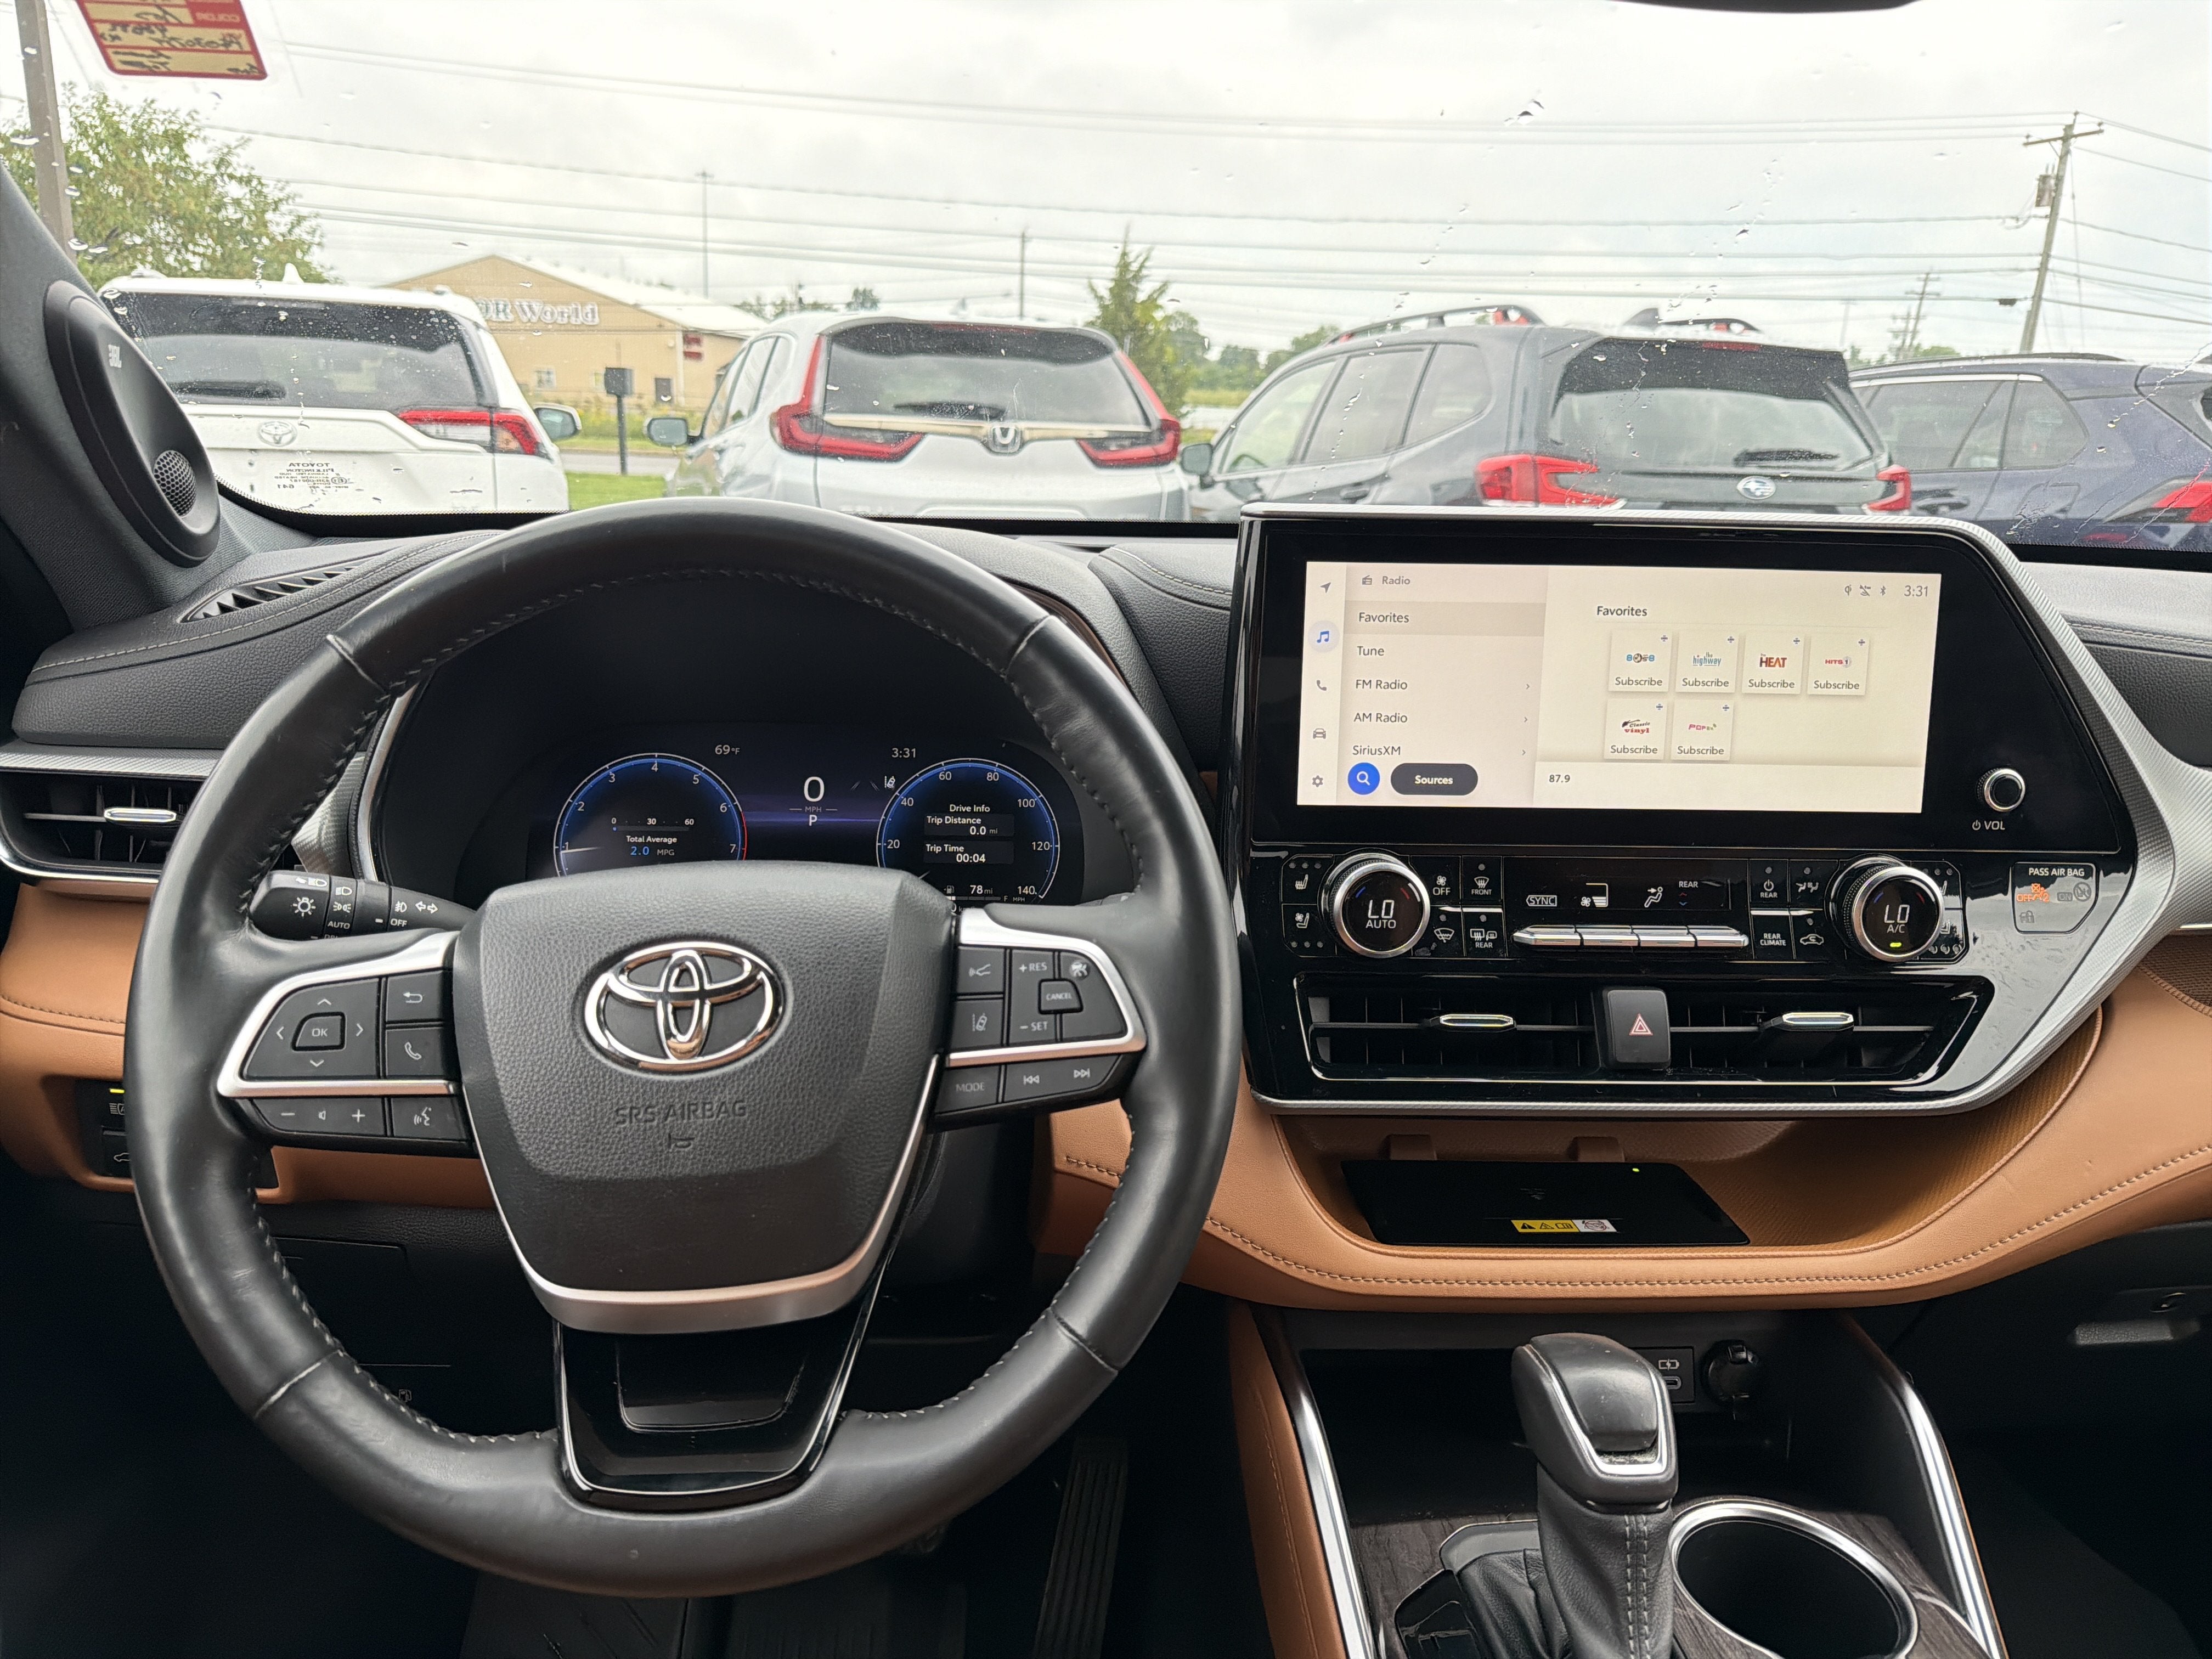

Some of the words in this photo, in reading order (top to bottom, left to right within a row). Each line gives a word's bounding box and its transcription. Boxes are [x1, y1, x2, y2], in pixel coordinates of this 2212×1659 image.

[514, 299, 599, 325] World
[1381, 575, 1410, 585] Radio
[1904, 585, 1928, 597] 3:31
[1596, 606, 1648, 617] Favorites
[1358, 612, 1409, 623] Favorites
[1357, 646, 1385, 656] Tune
[1692, 654, 1722, 666] highway
[1759, 657, 1787, 668] HEAT
[1356, 680, 1372, 690] FM
[1375, 679, 1408, 690] Radio
[1615, 676, 1663, 686] Subscribe
[1681, 678, 1729, 687] Subscribe
[1748, 679, 1795, 689] Subscribe
[1813, 680, 1860, 690] Subscribe
[1353, 713, 1372, 723] AM
[1375, 712, 1408, 723] Radio
[715, 744, 740, 755] 69°F
[891, 748, 916, 758] 3:31
[1352, 745, 1401, 756] SiriusXM
[1610, 745, 1658, 754] Subscribe
[1677, 746, 1724, 755] Subscribe
[651, 763, 658, 772] 4
[608, 774, 616, 783] 3
[693, 775, 699, 784] 5
[939, 771, 952, 781] 60
[986, 772, 999, 781] 80
[1414, 775, 1454, 785] Sources
[1549, 774, 1571, 783] 87.9
[804, 776, 825, 802] 0
[577, 802, 585, 811] 2
[720, 803, 727, 812] 6
[901, 798, 914, 807] 40
[1017, 798, 1035, 808] 100
[950, 804, 972, 812] Drive
[973, 804, 990, 812] Info
[809, 814, 817, 826] P
[926, 816, 943, 825] Trip
[969, 826, 986, 835] 0.0
[1984, 820, 2006, 831] VOL
[646, 836, 678, 845] Average
[887, 839, 900, 849] 20
[565, 841, 569, 851] 1
[630, 846, 650, 856] 2.0
[730, 844, 736, 853] 7
[926, 844, 942, 853] Trip
[944, 844, 964, 852] Time
[1031, 841, 1049, 851] 120
[956, 853, 986, 863] 00:04
[2028, 868, 2049, 876] PASS
[2051, 868, 2066, 876] AIR
[2067, 868, 2085, 877] BAG
[970, 885, 983, 895] 78
[1017, 885, 1035, 895] 140
[1432, 887, 1451, 896] OFF
[1529, 896, 1555, 905] SYNC
[2016, 894, 2032, 902] OFF
[328, 921, 351, 929] AUTO
[390, 918, 408, 927] OFF
[1365, 919, 1396, 929] AUTO
[1887, 924, 1905, 933] A/C
[312, 1028, 328, 1037] OK
[955, 1082, 985, 1092] MODE
[614, 1105, 658, 1125] SRS
[663, 1099, 747, 1122] AIRBAG
